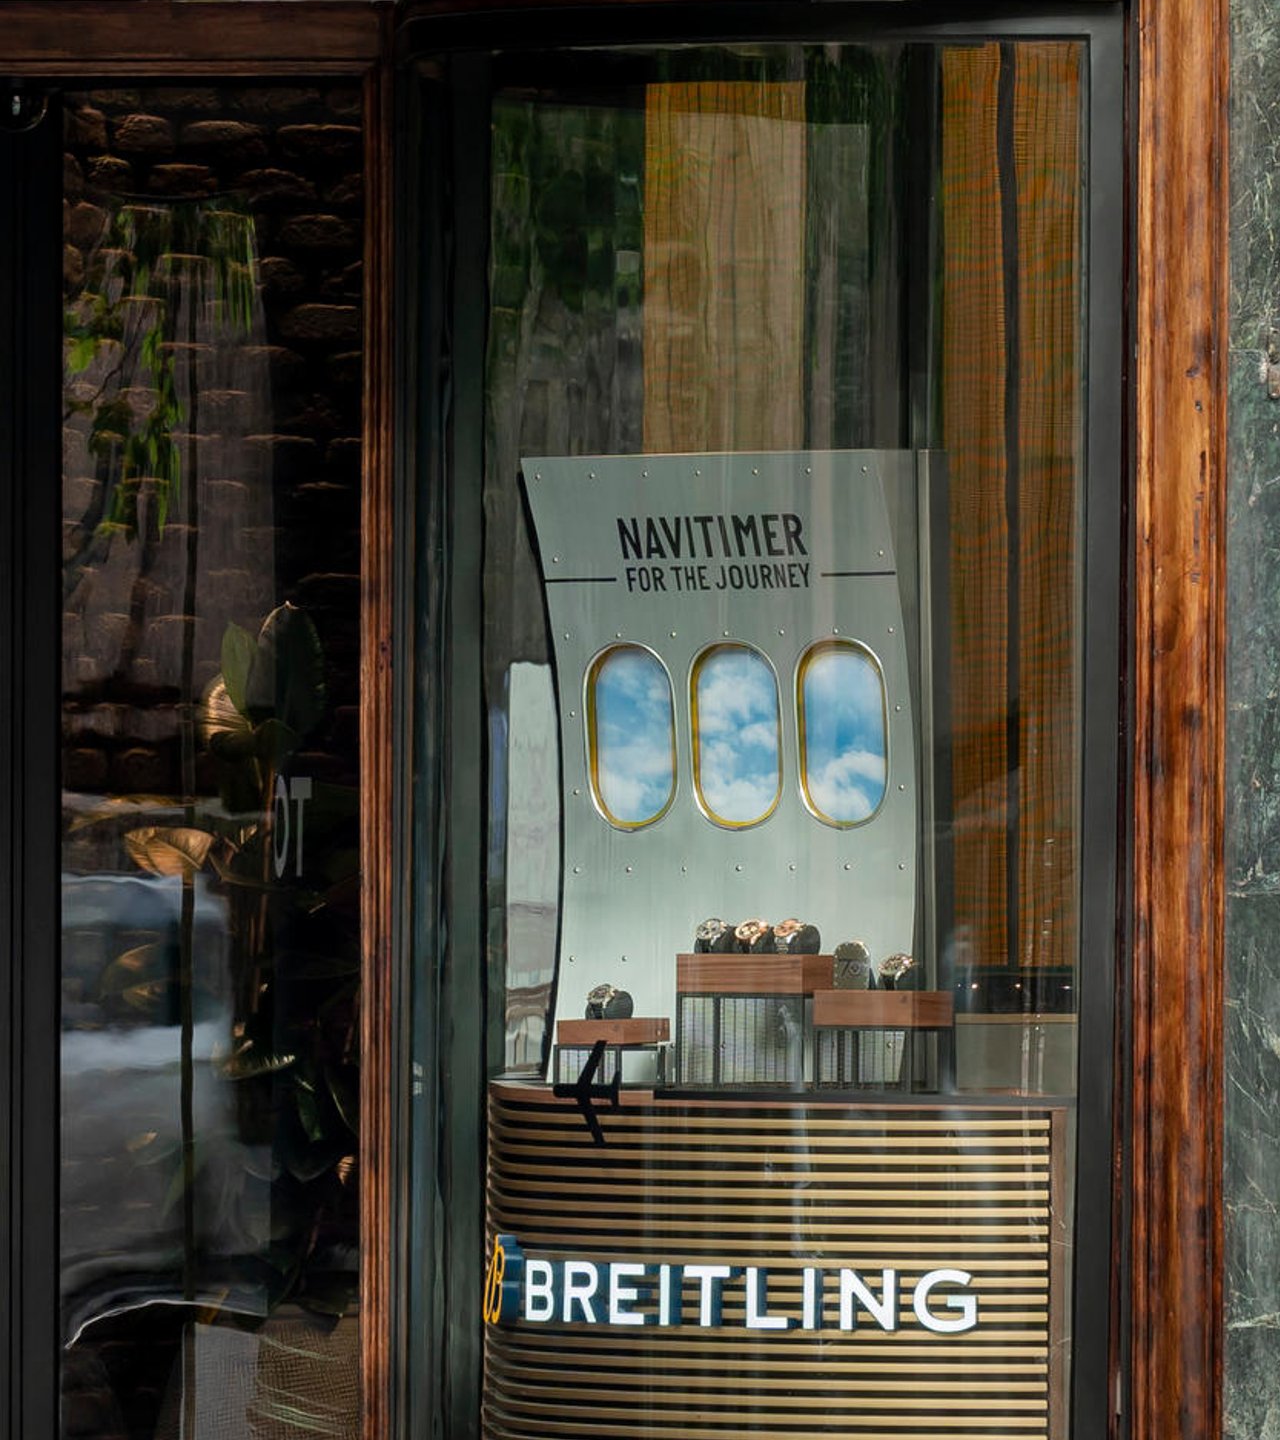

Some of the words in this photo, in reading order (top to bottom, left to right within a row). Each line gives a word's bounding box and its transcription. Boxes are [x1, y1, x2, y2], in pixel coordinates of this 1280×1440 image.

[616, 513, 808, 560] NAVITIMER
[626, 566, 667, 593] FOR
[670, 565, 711, 591] THE
[715, 563, 810, 590] JOURNEY
[524, 1259, 979, 1333] BREITLING
